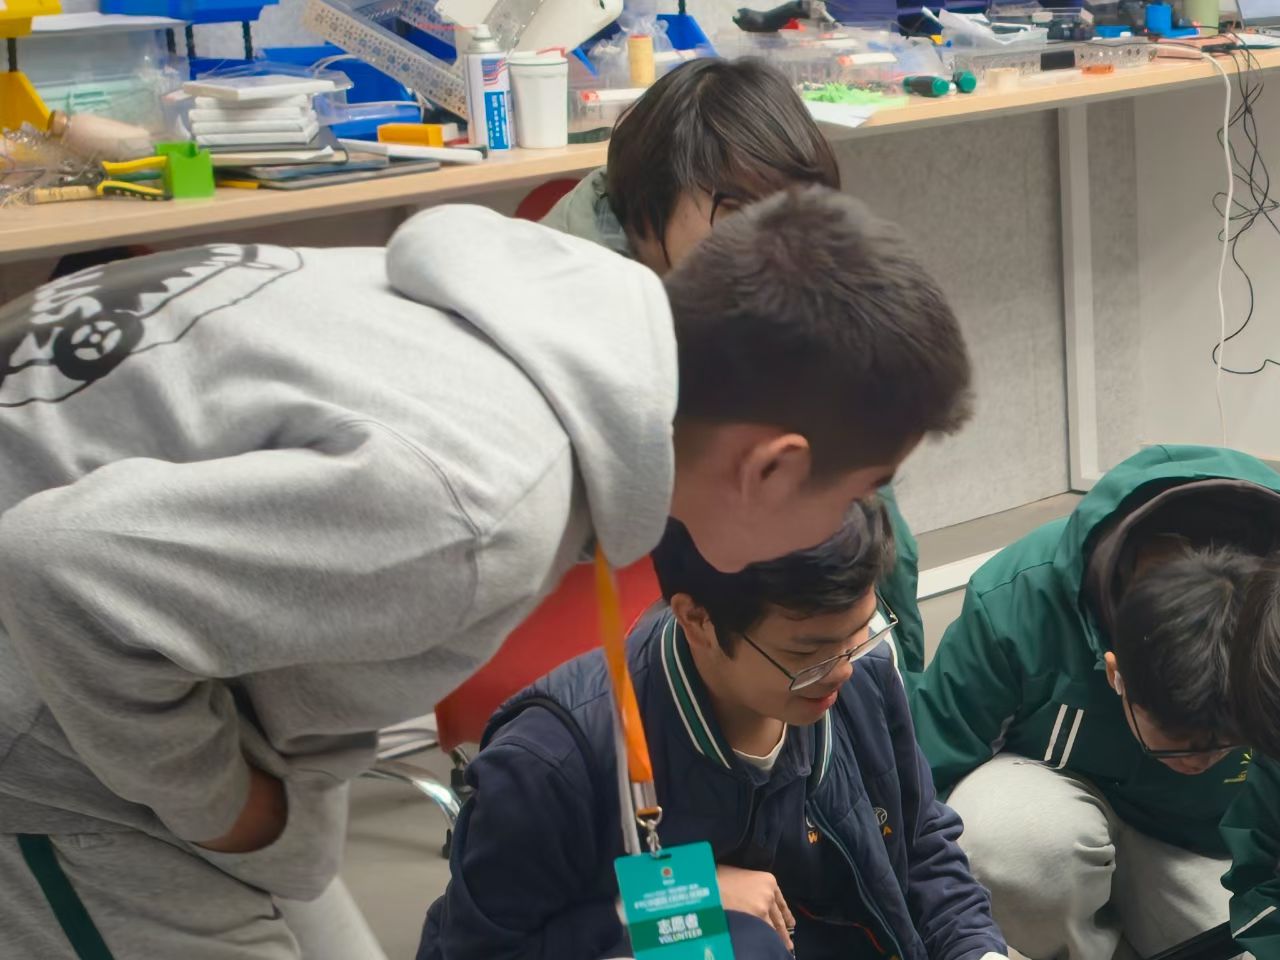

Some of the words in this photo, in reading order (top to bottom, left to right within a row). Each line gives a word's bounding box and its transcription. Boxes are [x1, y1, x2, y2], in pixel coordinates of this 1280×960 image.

[657, 912, 699, 935] 志愿者
[658, 927, 702, 944] VOLUNTEER
